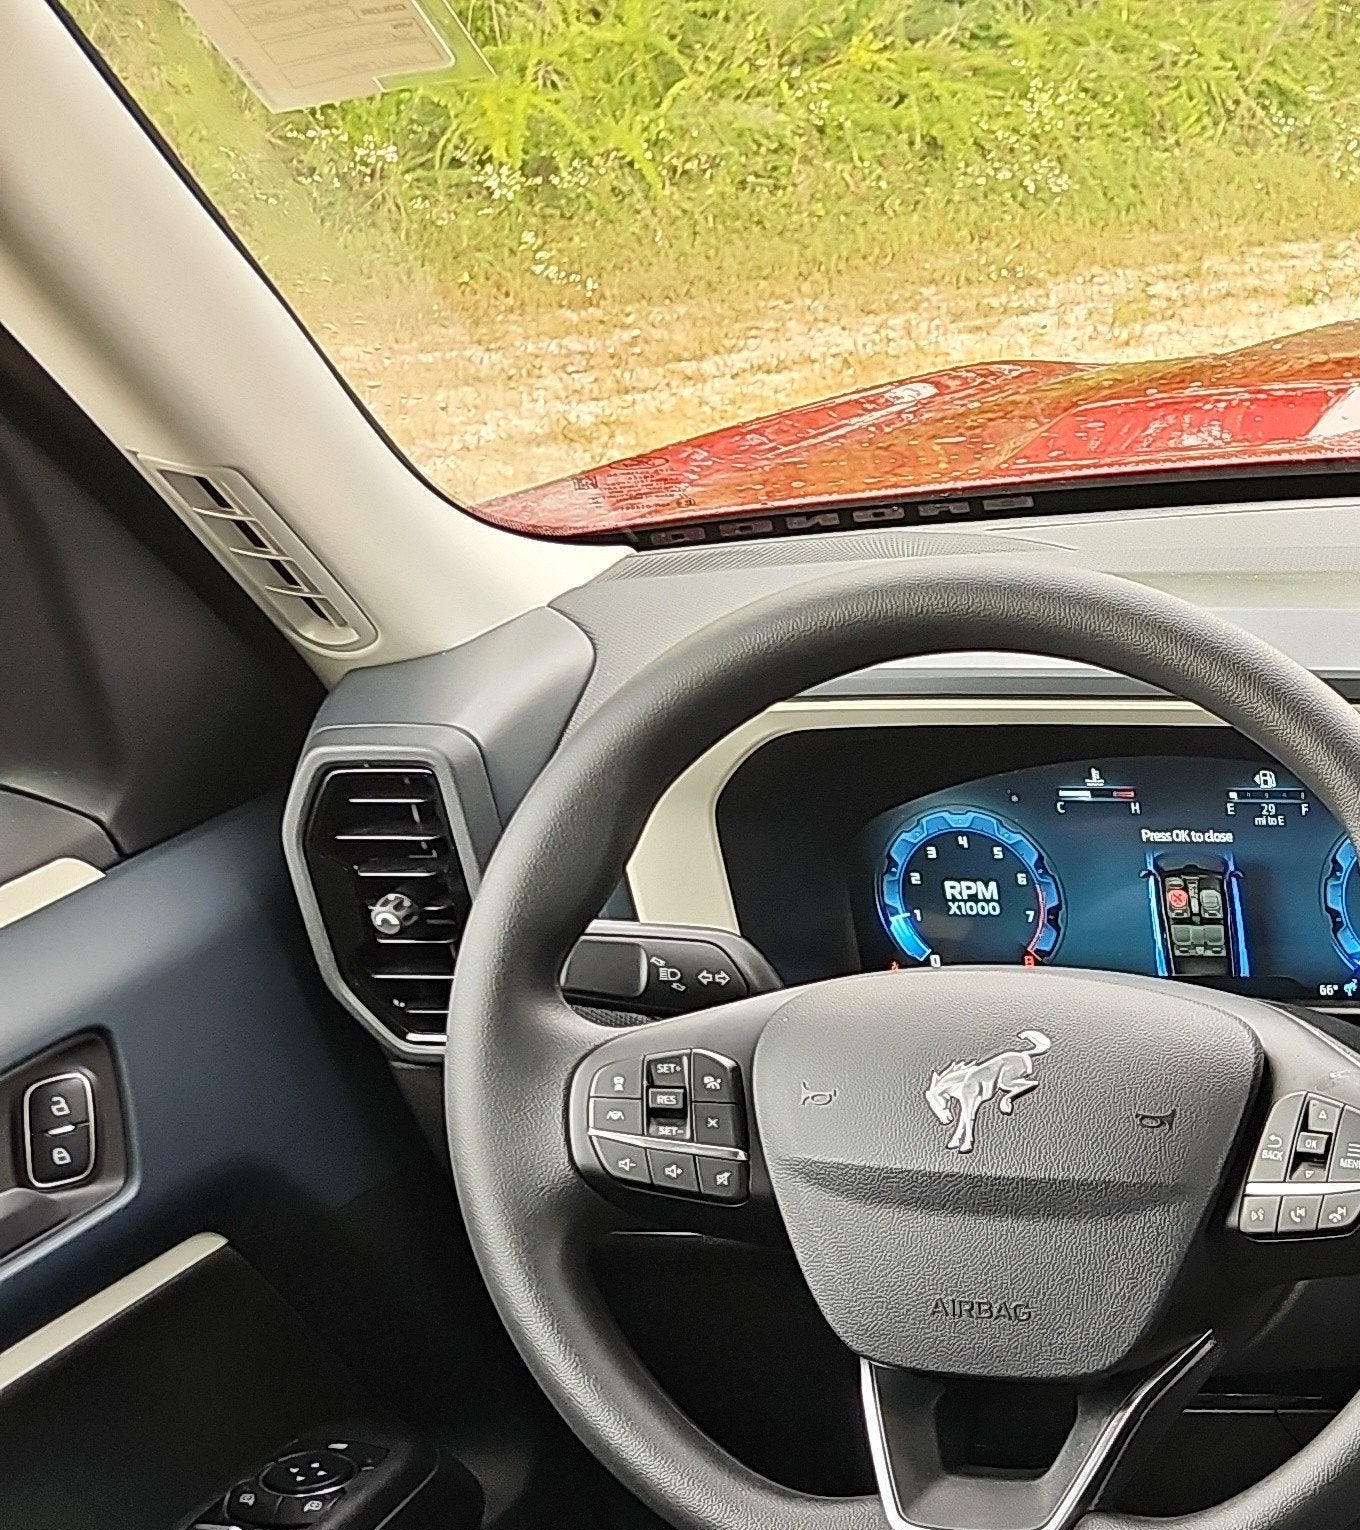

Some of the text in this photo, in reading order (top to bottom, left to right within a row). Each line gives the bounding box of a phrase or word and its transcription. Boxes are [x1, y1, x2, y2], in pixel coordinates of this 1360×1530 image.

[1057, 802, 1065, 813] C
[1131, 803, 1140, 814] H
[1227, 804, 1234, 815] E
[1261, 804, 1276, 815] 29
[1301, 804, 1309, 815] F
[1254, 815, 1265, 826] mi
[957, 836, 968, 848] 4
[1141, 830, 1233, 843] Press OK to close
[926, 846, 936, 859] 3
[993, 847, 1004, 859] 5
[910, 872, 921, 885] 2
[1016, 873, 1027, 886] 6
[943, 881, 998, 900] RPM
[948, 900, 1000, 917] X1000
[915, 911, 922, 922] 1
[1026, 910, 1035, 922] 7
[931, 954, 941, 968] 0
[1319, 984, 1338, 995] 66°
[656, 1094, 677, 1105] RES
[1305, 1138, 1317, 1149] OK
[1261, 1149, 1284, 1161] BACK
[930, 1298, 1033, 1322] AIRBAG
